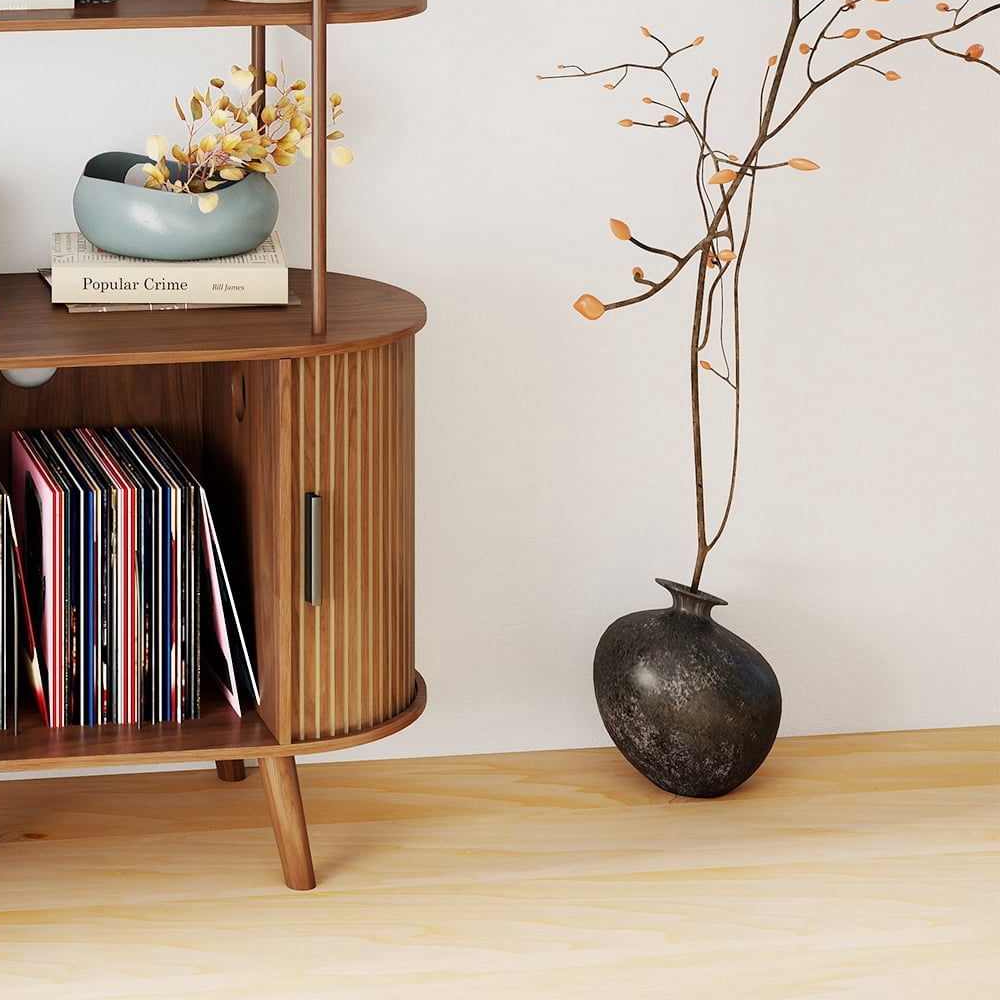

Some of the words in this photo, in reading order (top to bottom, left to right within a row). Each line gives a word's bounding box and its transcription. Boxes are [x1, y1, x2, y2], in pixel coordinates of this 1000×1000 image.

[82, 277, 139, 293] Popular
[143, 277, 188, 291] Crime
[211, 283, 223, 291] Bill
[223, 283, 245, 293] James
